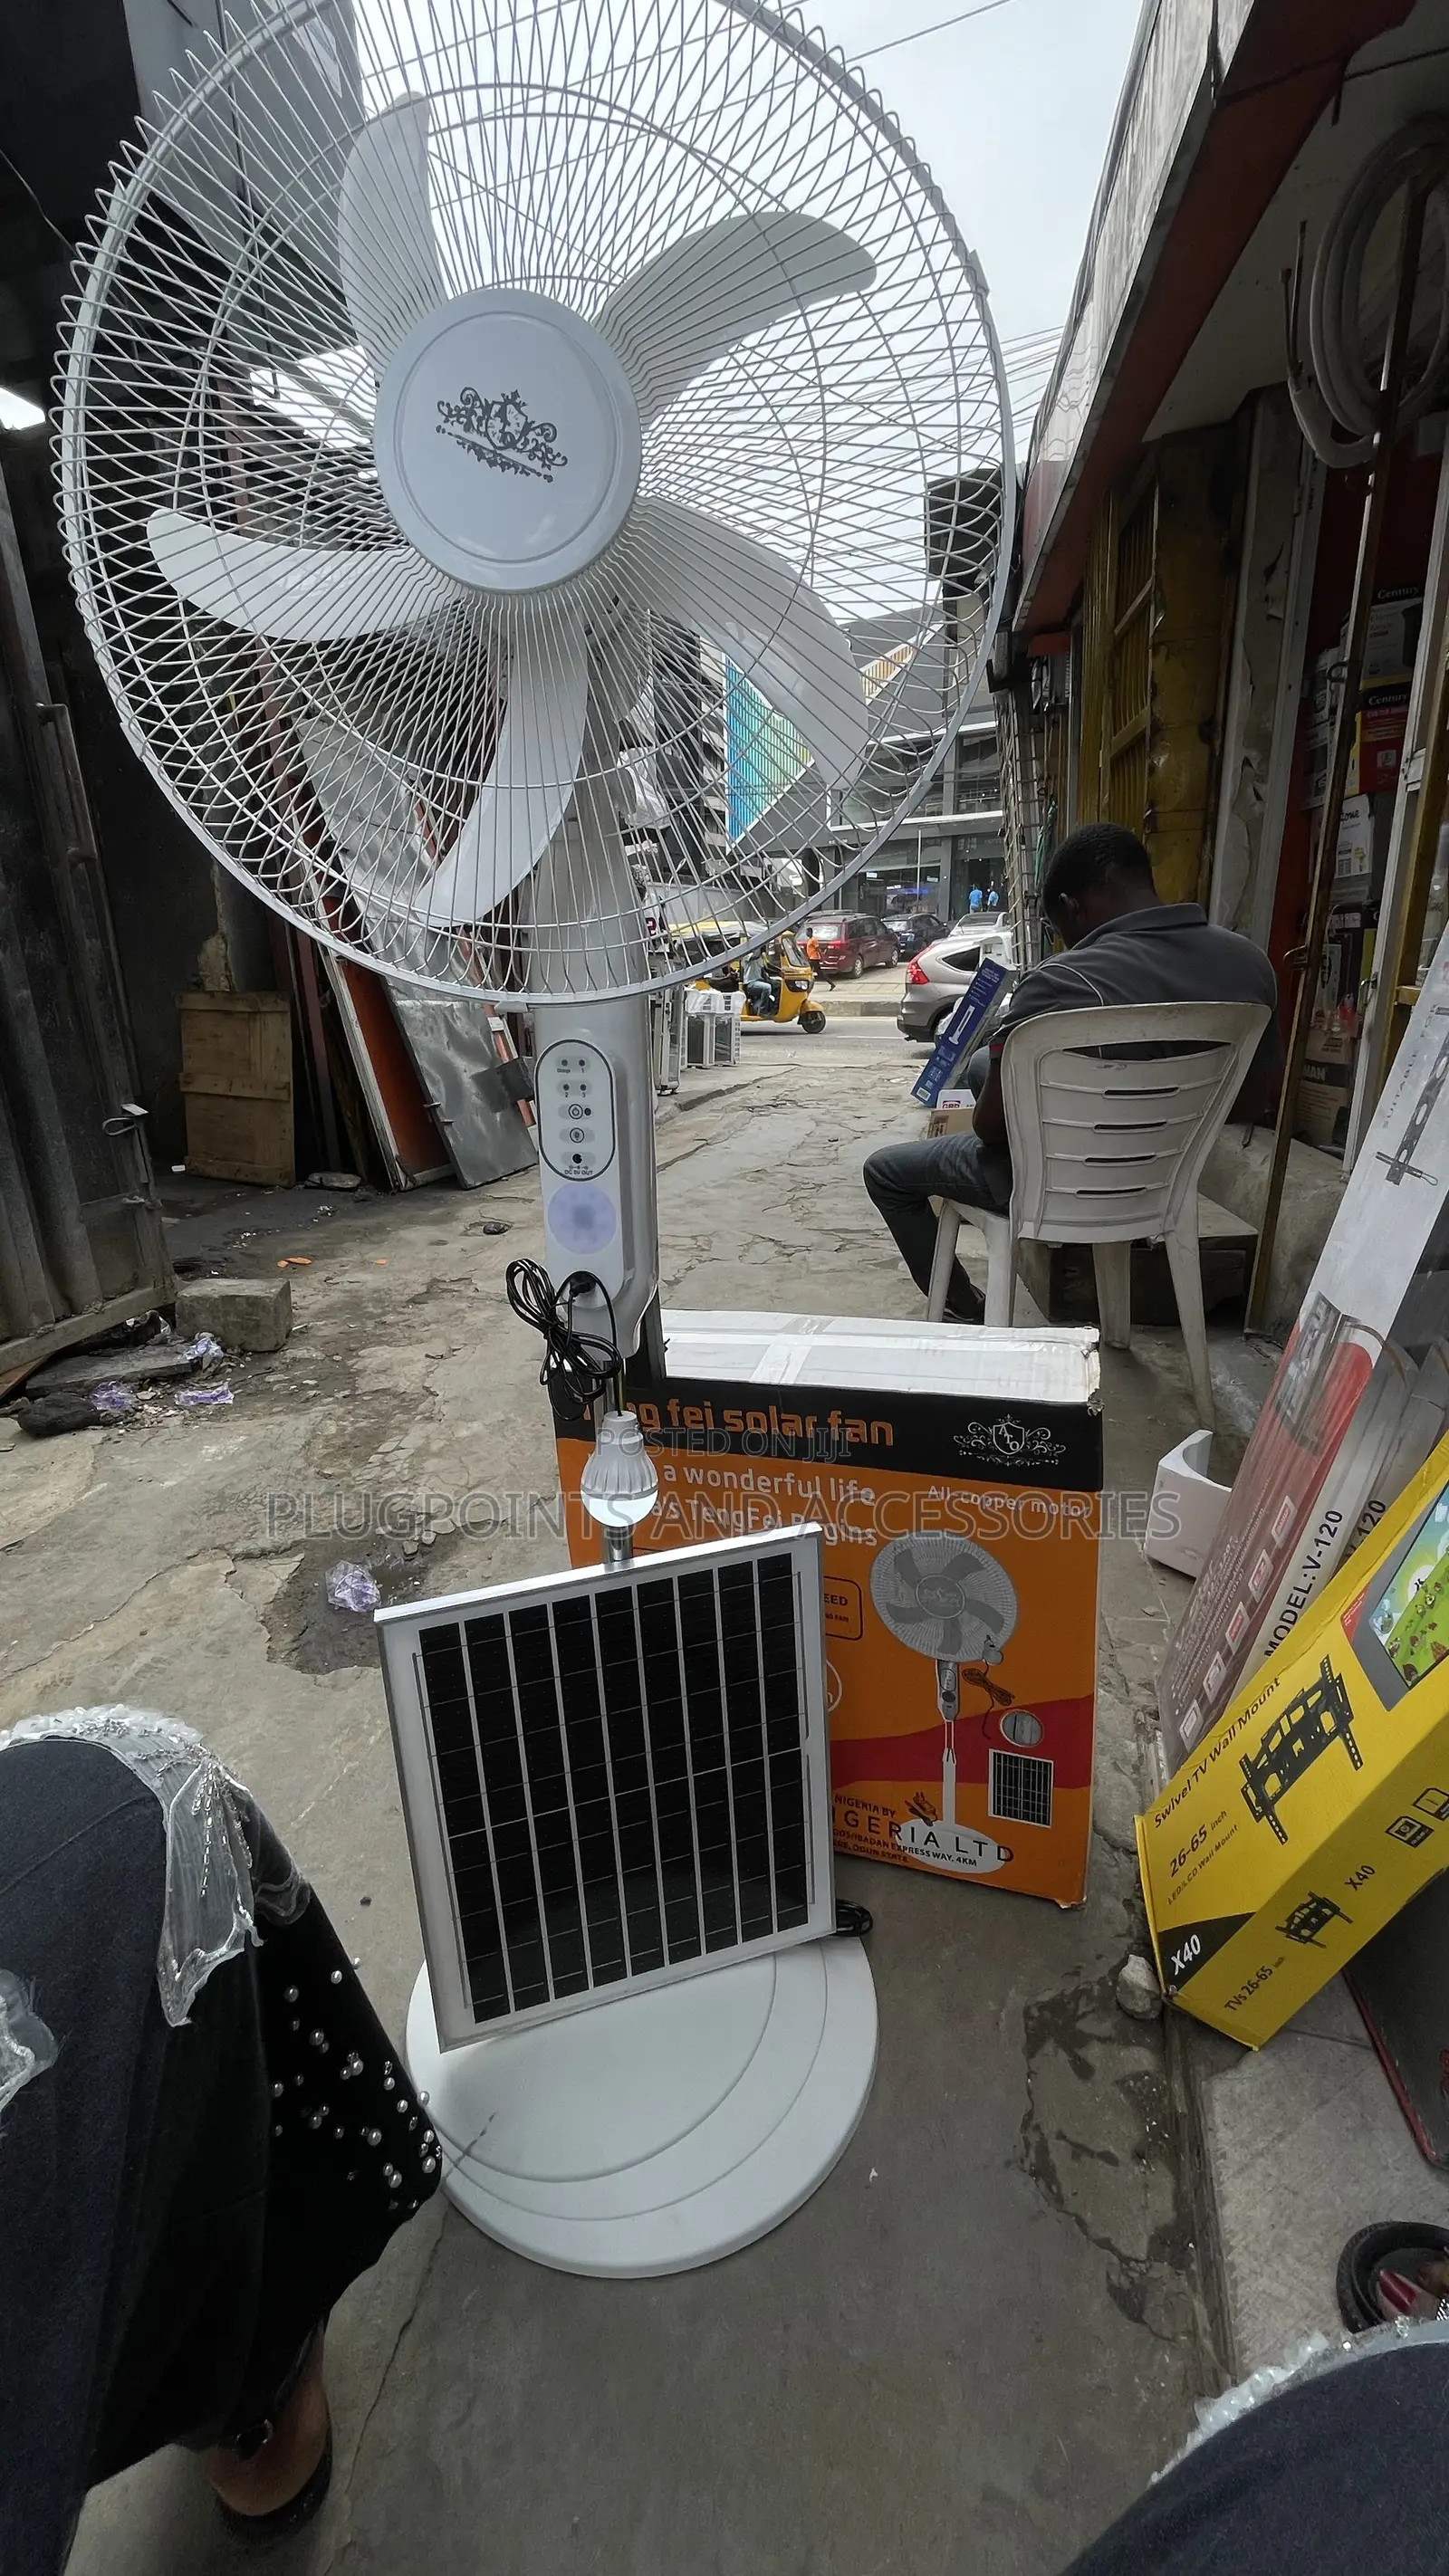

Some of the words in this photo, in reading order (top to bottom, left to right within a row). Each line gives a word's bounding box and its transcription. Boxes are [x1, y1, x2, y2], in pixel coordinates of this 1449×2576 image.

[1377, 588, 1419, 599] Century
[1368, 692, 1407, 705] Century
[667, 1398, 714, 1431] fei
[724, 1405, 818, 1438] solar
[827, 1411, 894, 1446] fan
[663, 1463, 677, 1482] a
[683, 1466, 821, 1499] wonderful
[830, 1476, 876, 1507] life
[927, 1485, 1024, 1511] All-copper
[1031, 1499, 1091, 1518] motor
[686, 1499, 782, 1531] TengFei
[791, 1512, 878, 1547] Bgins
[823, 1593, 849, 1607] EED
[1155, 1779, 1193, 1829] Swivel
[1192, 1759, 1208, 1784] TV
[1209, 1727, 1237, 1762] Wall
[1238, 1677, 1281, 1730] Mount
[834, 1795, 879, 1815] NIGERIA
[882, 1806, 896, 1819] BY
[831, 1805, 939, 1849] IGERIA
[955, 1836, 1014, 1863] LTD
[1169, 1824, 1207, 1877] 26-65
[1210, 1810, 1228, 1832] inch
[955, 1855, 977, 1866] 4KM
[1167, 1869, 1198, 1905] LED/LCD
[1198, 1849, 1214, 1871] Wall
[1214, 1824, 1238, 1853] Mount
[1345, 1864, 1376, 1891] X40
[1170, 1933, 1202, 1976] X40
[1223, 1993, 1248, 2012] TVs
[1241, 1964, 1273, 1996] 26-65
